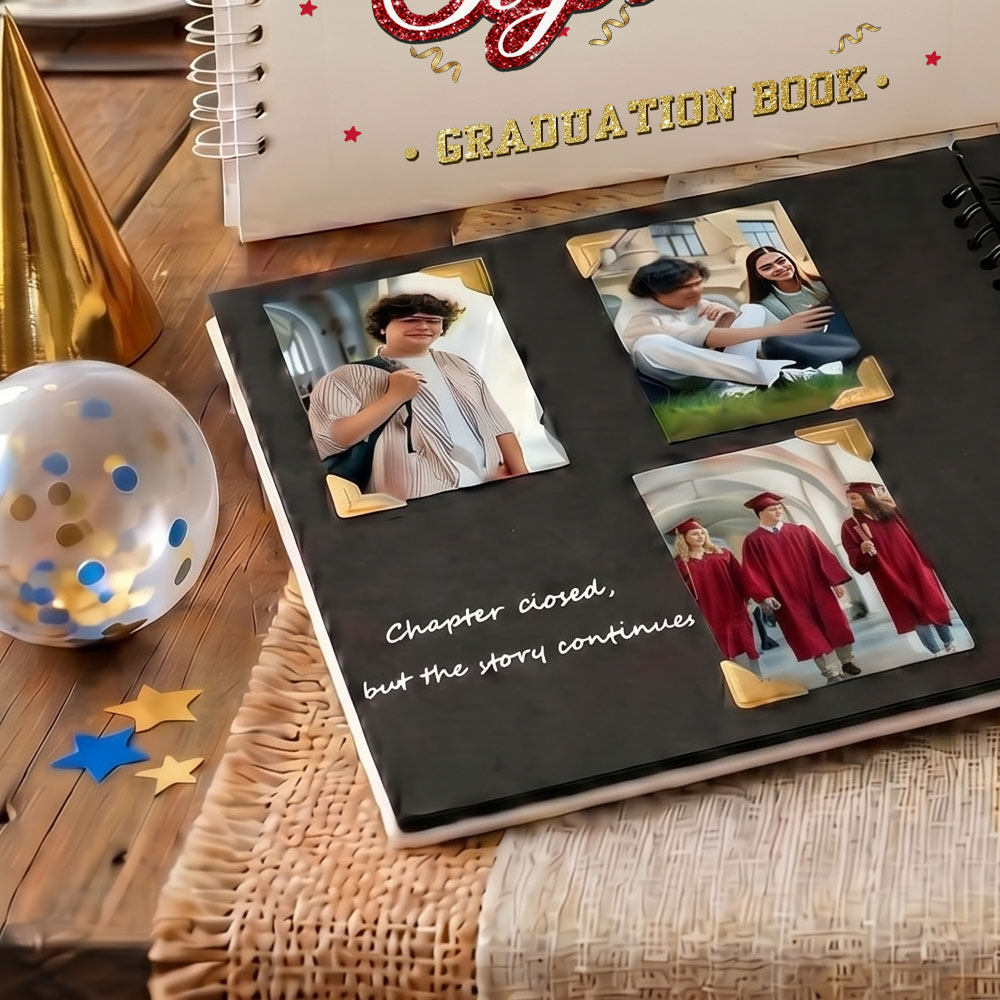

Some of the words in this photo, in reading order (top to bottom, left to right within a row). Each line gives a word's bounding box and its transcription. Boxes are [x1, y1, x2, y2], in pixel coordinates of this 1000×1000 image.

[435, 85, 737, 165] GRADUATION
[751, 65, 868, 118] BOOK
[363, 671, 414, 700] but
[419, 662, 470, 686] the
[479, 645, 547, 675] story
[558, 613, 697, 655] continues
[385, 606, 506, 644] Chapter
